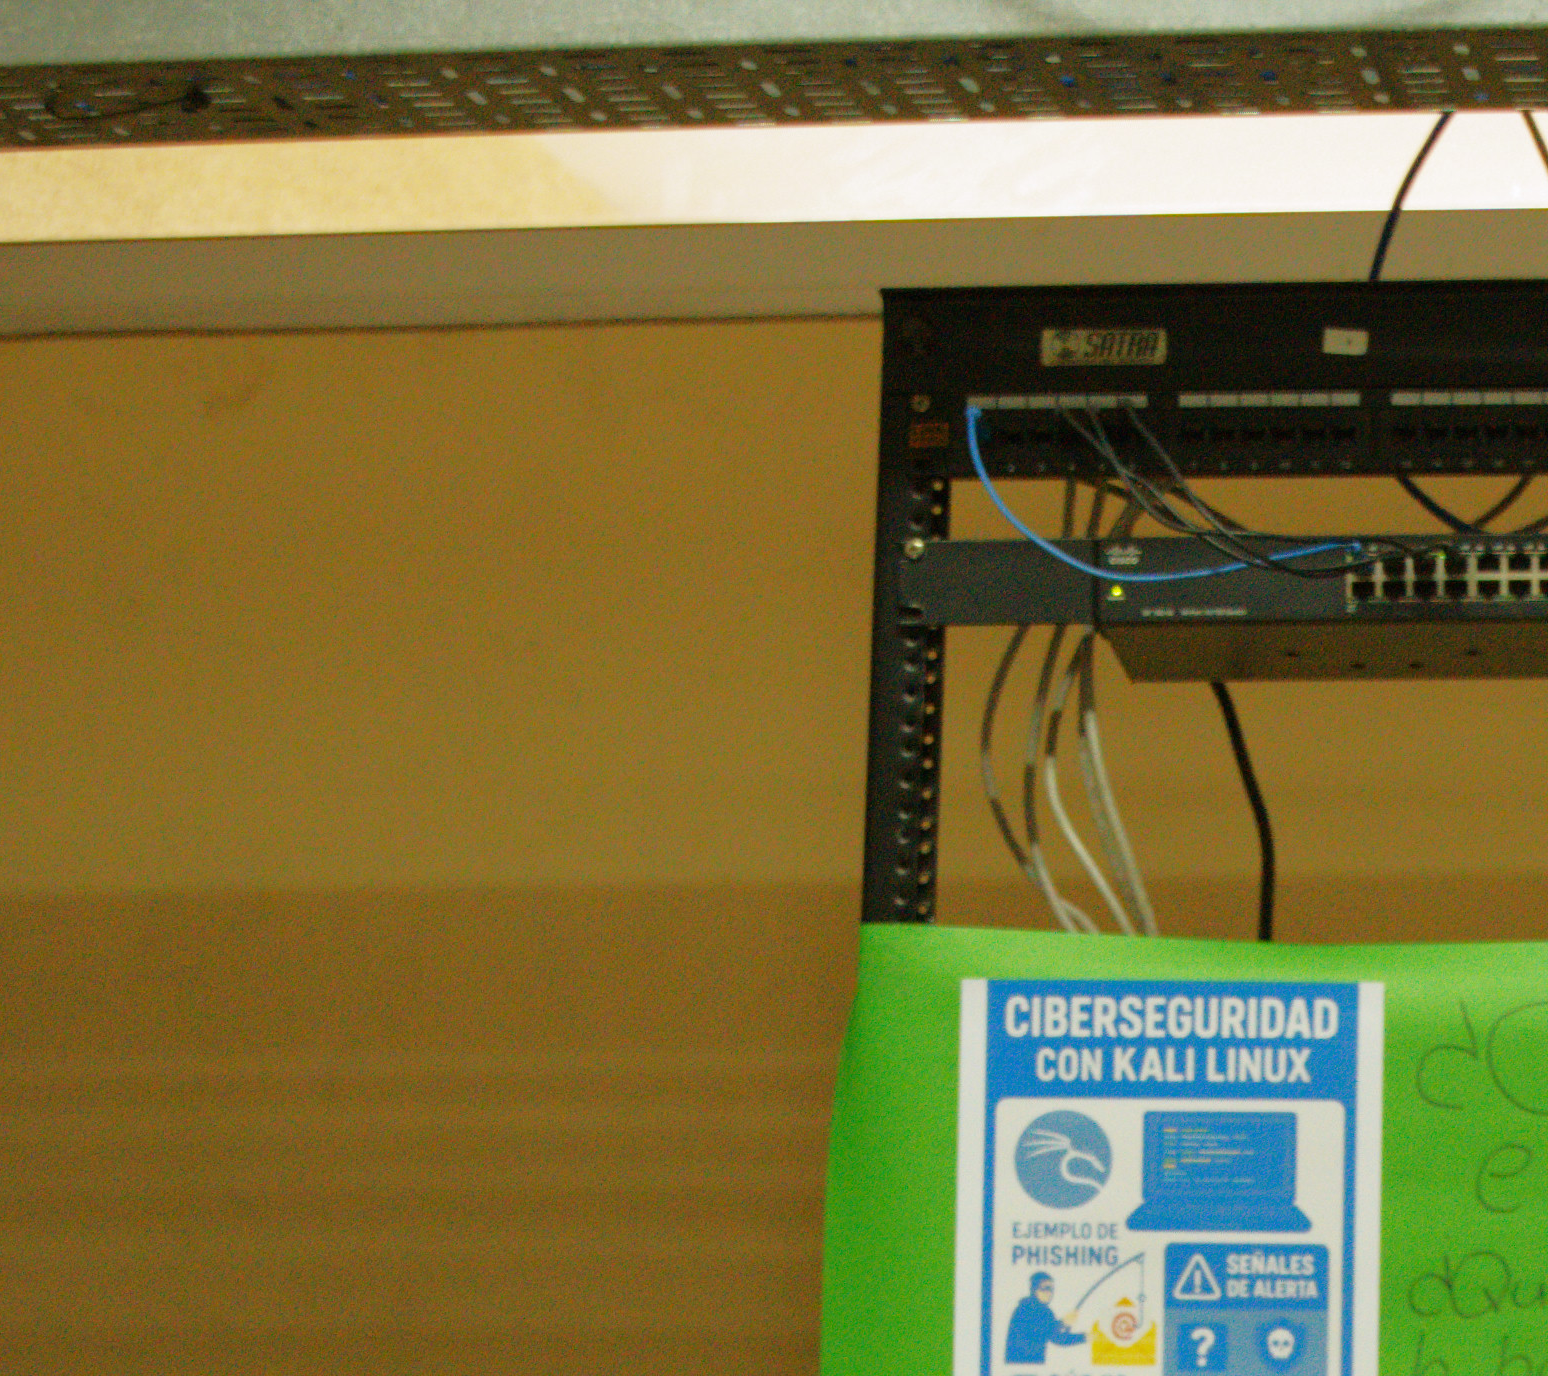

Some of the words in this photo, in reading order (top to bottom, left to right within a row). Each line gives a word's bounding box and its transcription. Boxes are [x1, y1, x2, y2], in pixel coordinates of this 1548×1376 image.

[1004, 995, 1340, 1042] CIBERSEGURIDAD
[1035, 1048, 1104, 1083] CON
[1111, 1047, 1201, 1083] KALI
[1207, 1048, 1313, 1085] LINUX
[1012, 1221, 1095, 1240] EJEMPLO
[1098, 1222, 1119, 1240] DE
[1011, 1244, 1120, 1267] PHISHING
[1225, 1252, 1315, 1276] SEÑALES
[1225, 1278, 1249, 1298] DE
[1253, 1278, 1319, 1299] ALERTA
